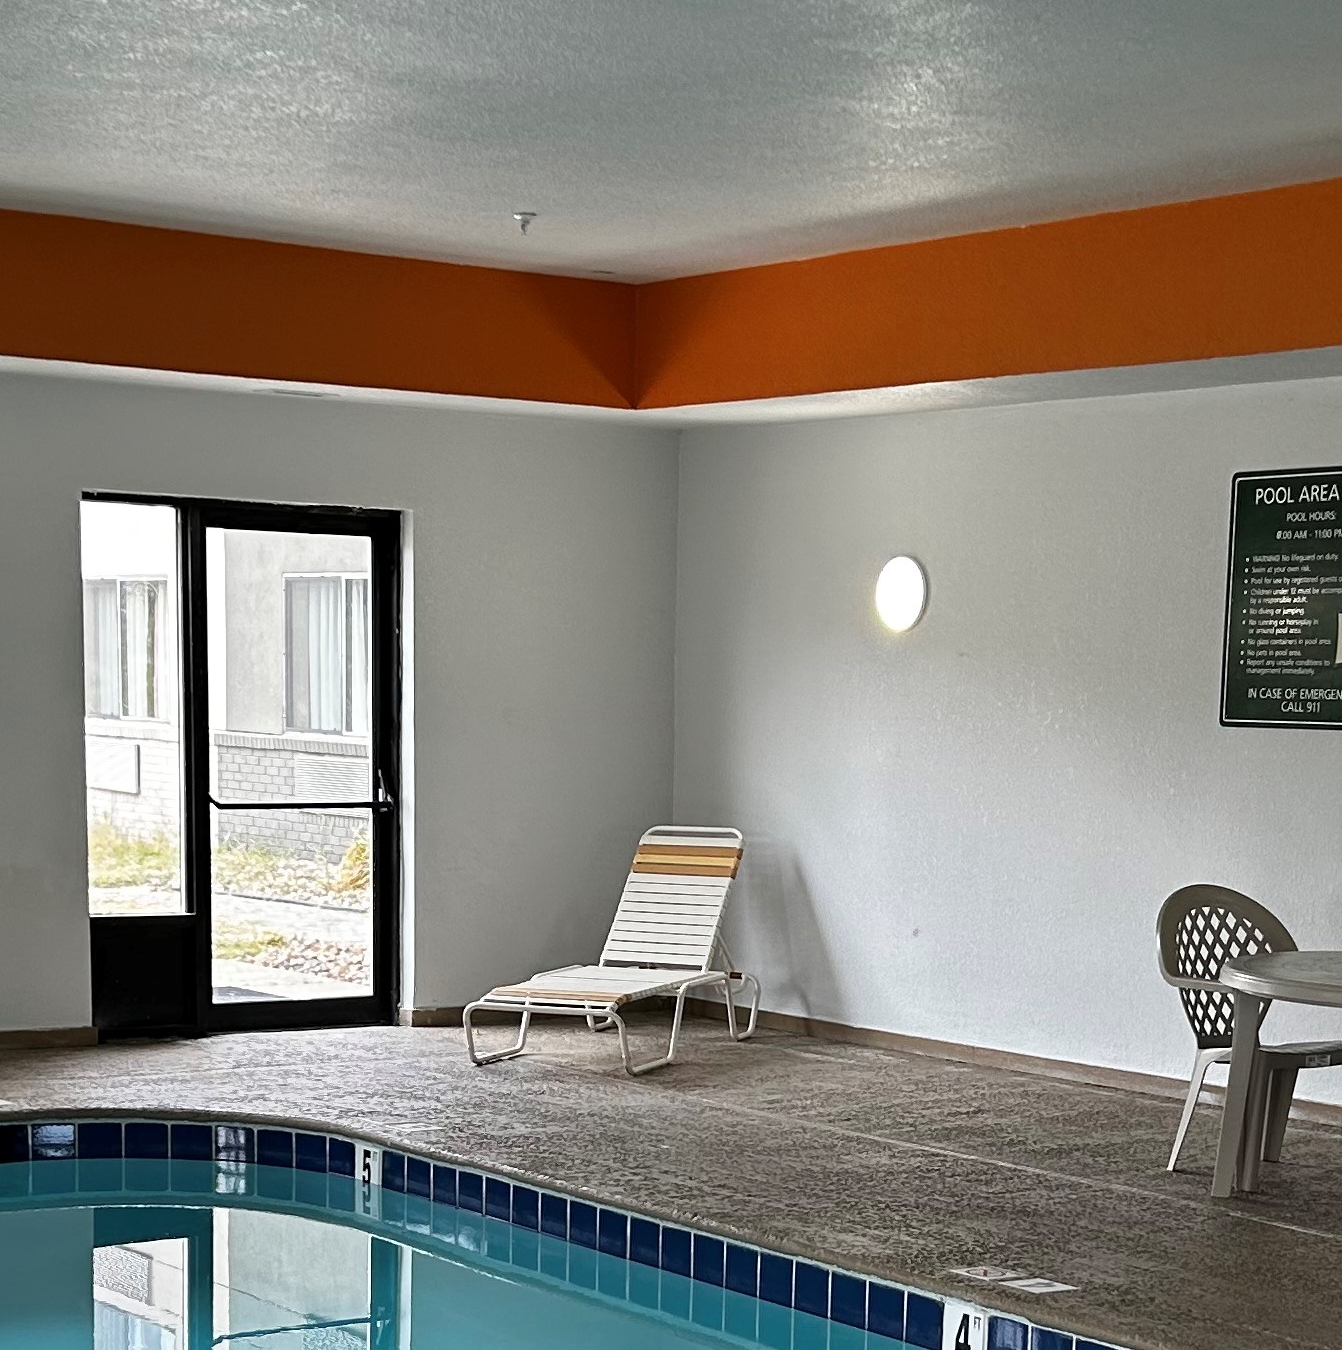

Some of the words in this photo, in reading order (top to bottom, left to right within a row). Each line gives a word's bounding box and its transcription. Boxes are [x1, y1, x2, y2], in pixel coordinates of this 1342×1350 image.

[1255, 486, 1295, 505] POOL
[1298, 483, 1340, 503] AREA
[1286, 511, 1308, 522] POOL
[1293, 529, 1308, 540] AM
[1247, 687, 1257, 699] IN
[1259, 687, 1282, 699] CASE
[1284, 688, 1298, 700] OF
[1281, 701, 1304, 713] CALL
[1306, 701, 1321, 713] 911
[362, 1149, 372, 1184] 5
